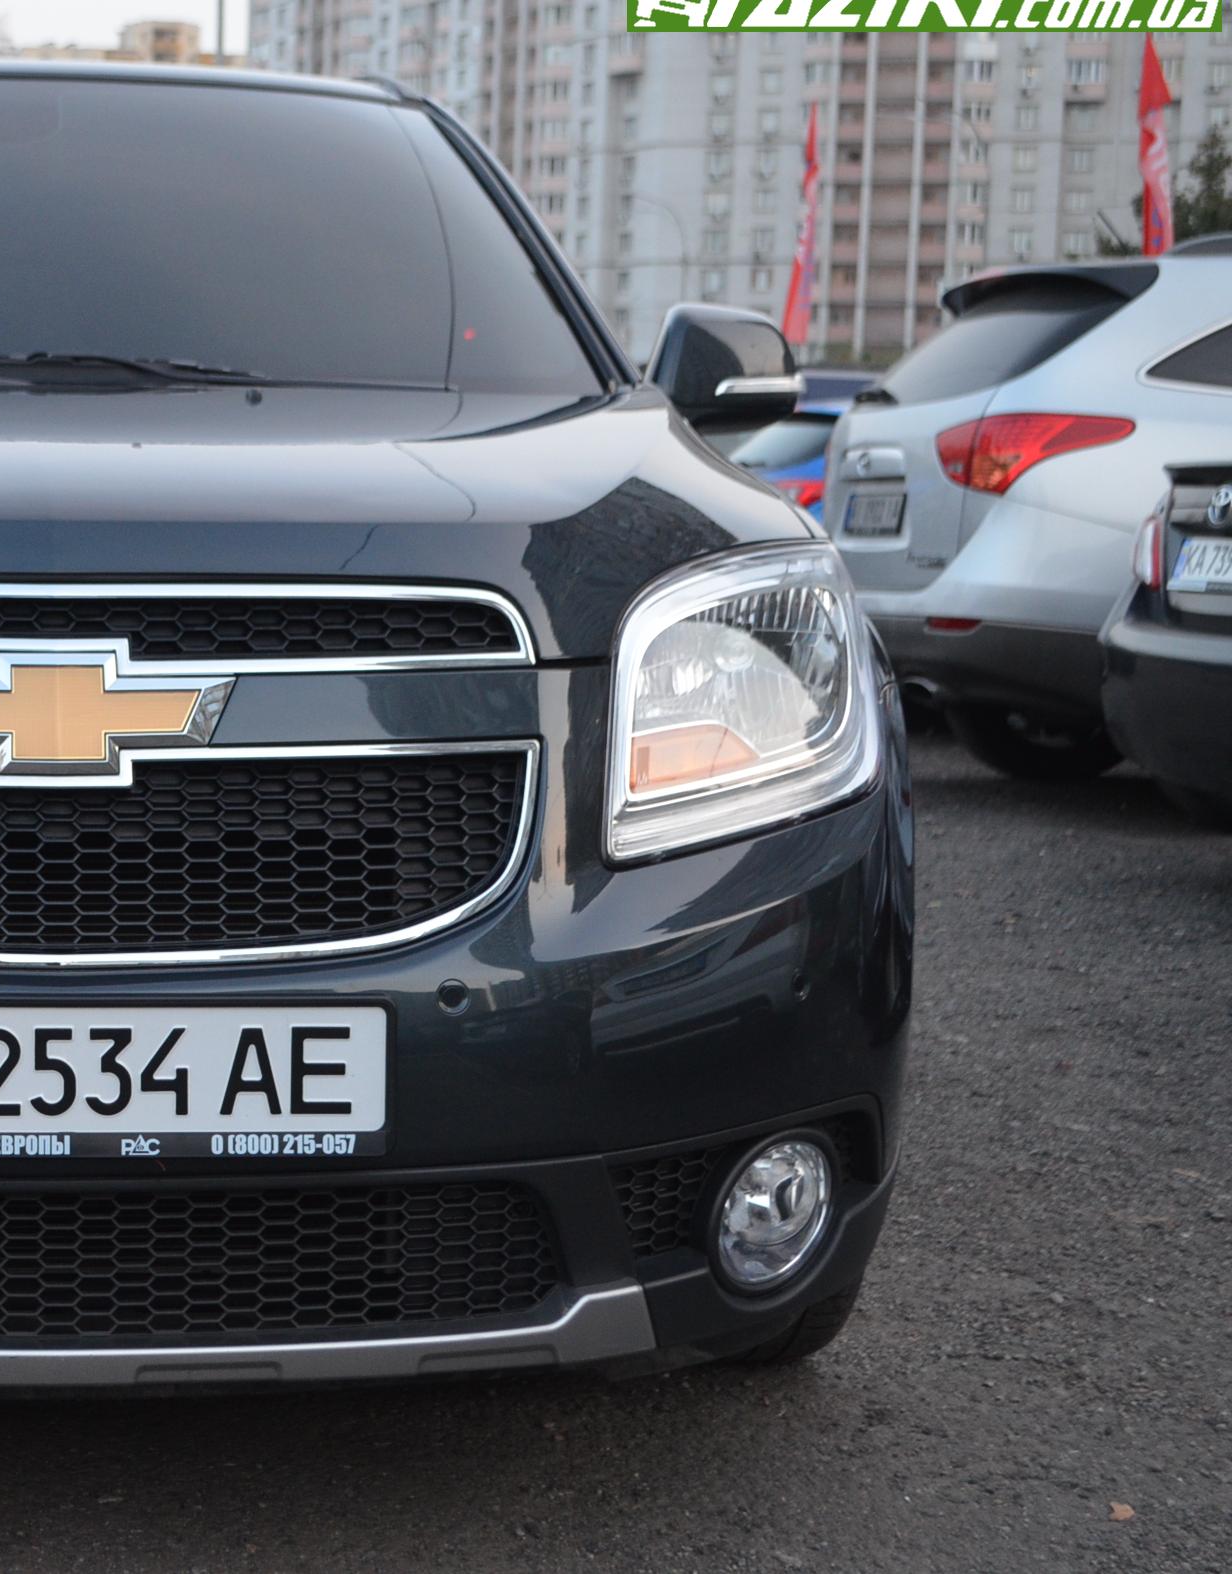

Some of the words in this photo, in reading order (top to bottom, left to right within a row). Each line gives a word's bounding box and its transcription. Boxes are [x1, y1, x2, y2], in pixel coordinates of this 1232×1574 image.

[219, 1025, 353, 1116] AE
[210, 1134, 223, 1155] 0
[227, 1134, 279, 1155] (800)
[282, 1134, 356, 1155] 215-057
